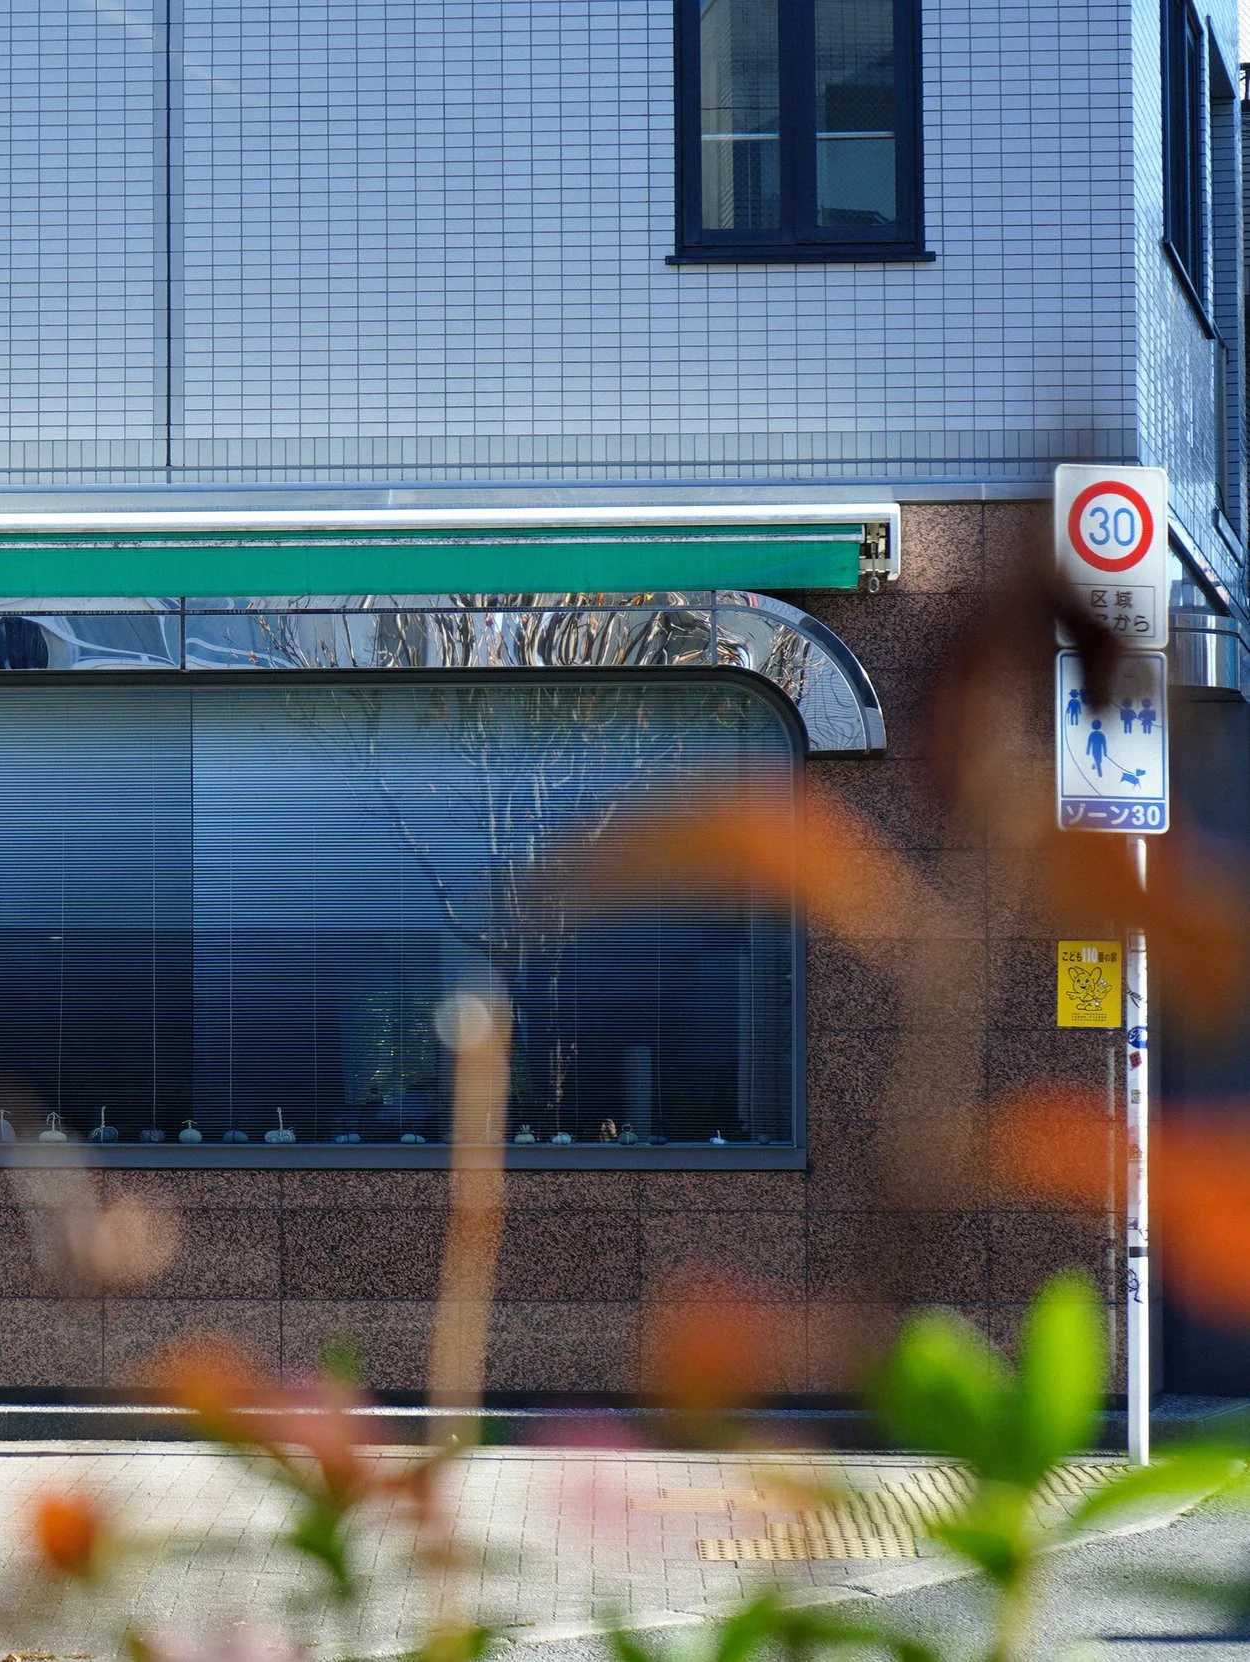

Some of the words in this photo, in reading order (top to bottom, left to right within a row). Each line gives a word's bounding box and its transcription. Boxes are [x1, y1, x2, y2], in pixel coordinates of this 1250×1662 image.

[1088, 506, 1137, 547] 30
[1091, 590, 1134, 609] 区域
[1065, 804, 1162, 828] ゾーン30
